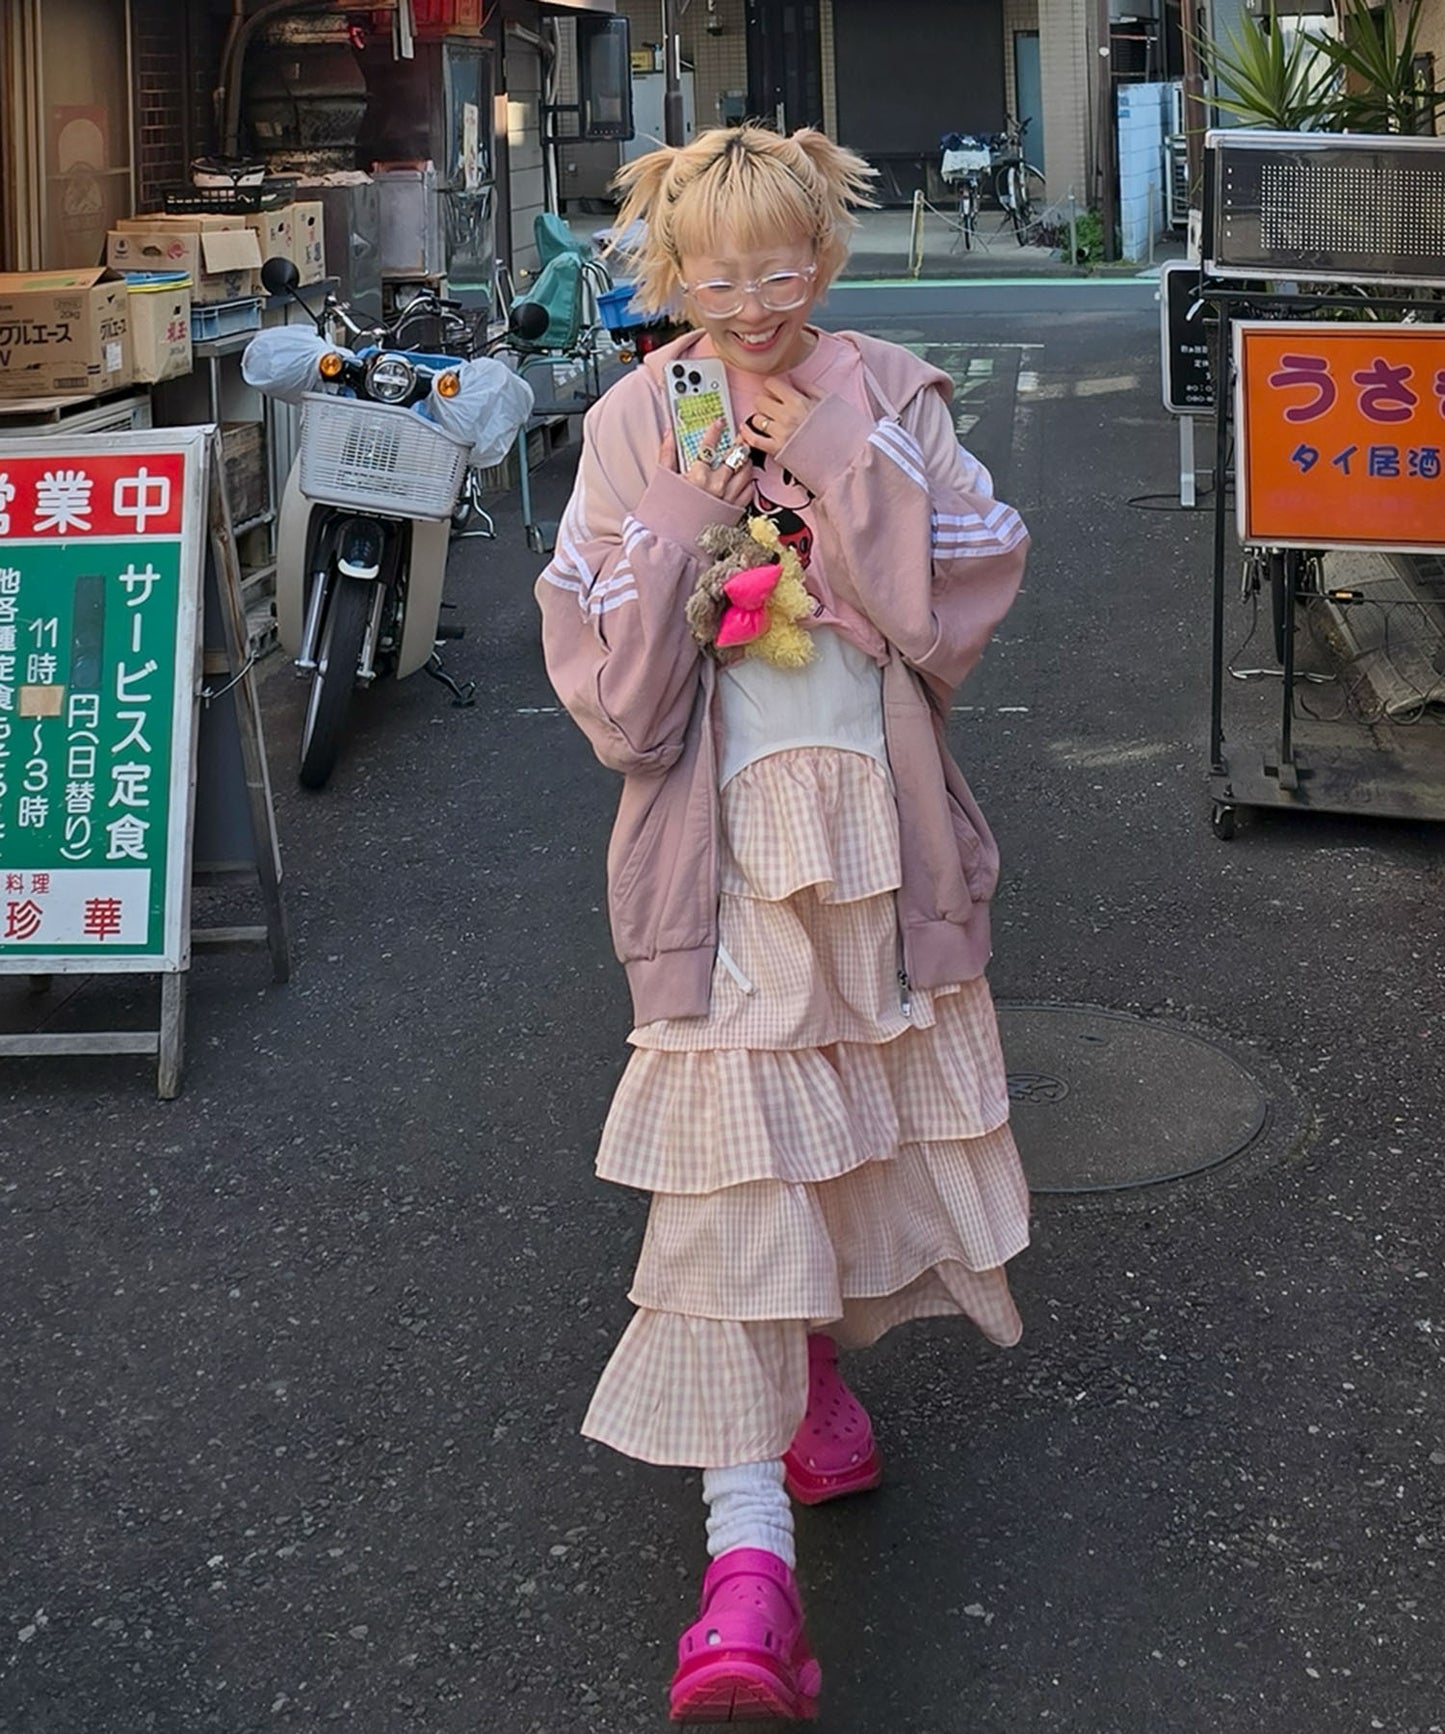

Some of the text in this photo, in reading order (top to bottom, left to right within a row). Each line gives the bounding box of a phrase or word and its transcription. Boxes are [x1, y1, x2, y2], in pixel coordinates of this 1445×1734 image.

[1291, 444, 1441, 478] タイ居酒
[0, 466, 171, 535] 業中
[105, 563, 161, 861] サービス定食
[5, 873, 50, 894] 料理
